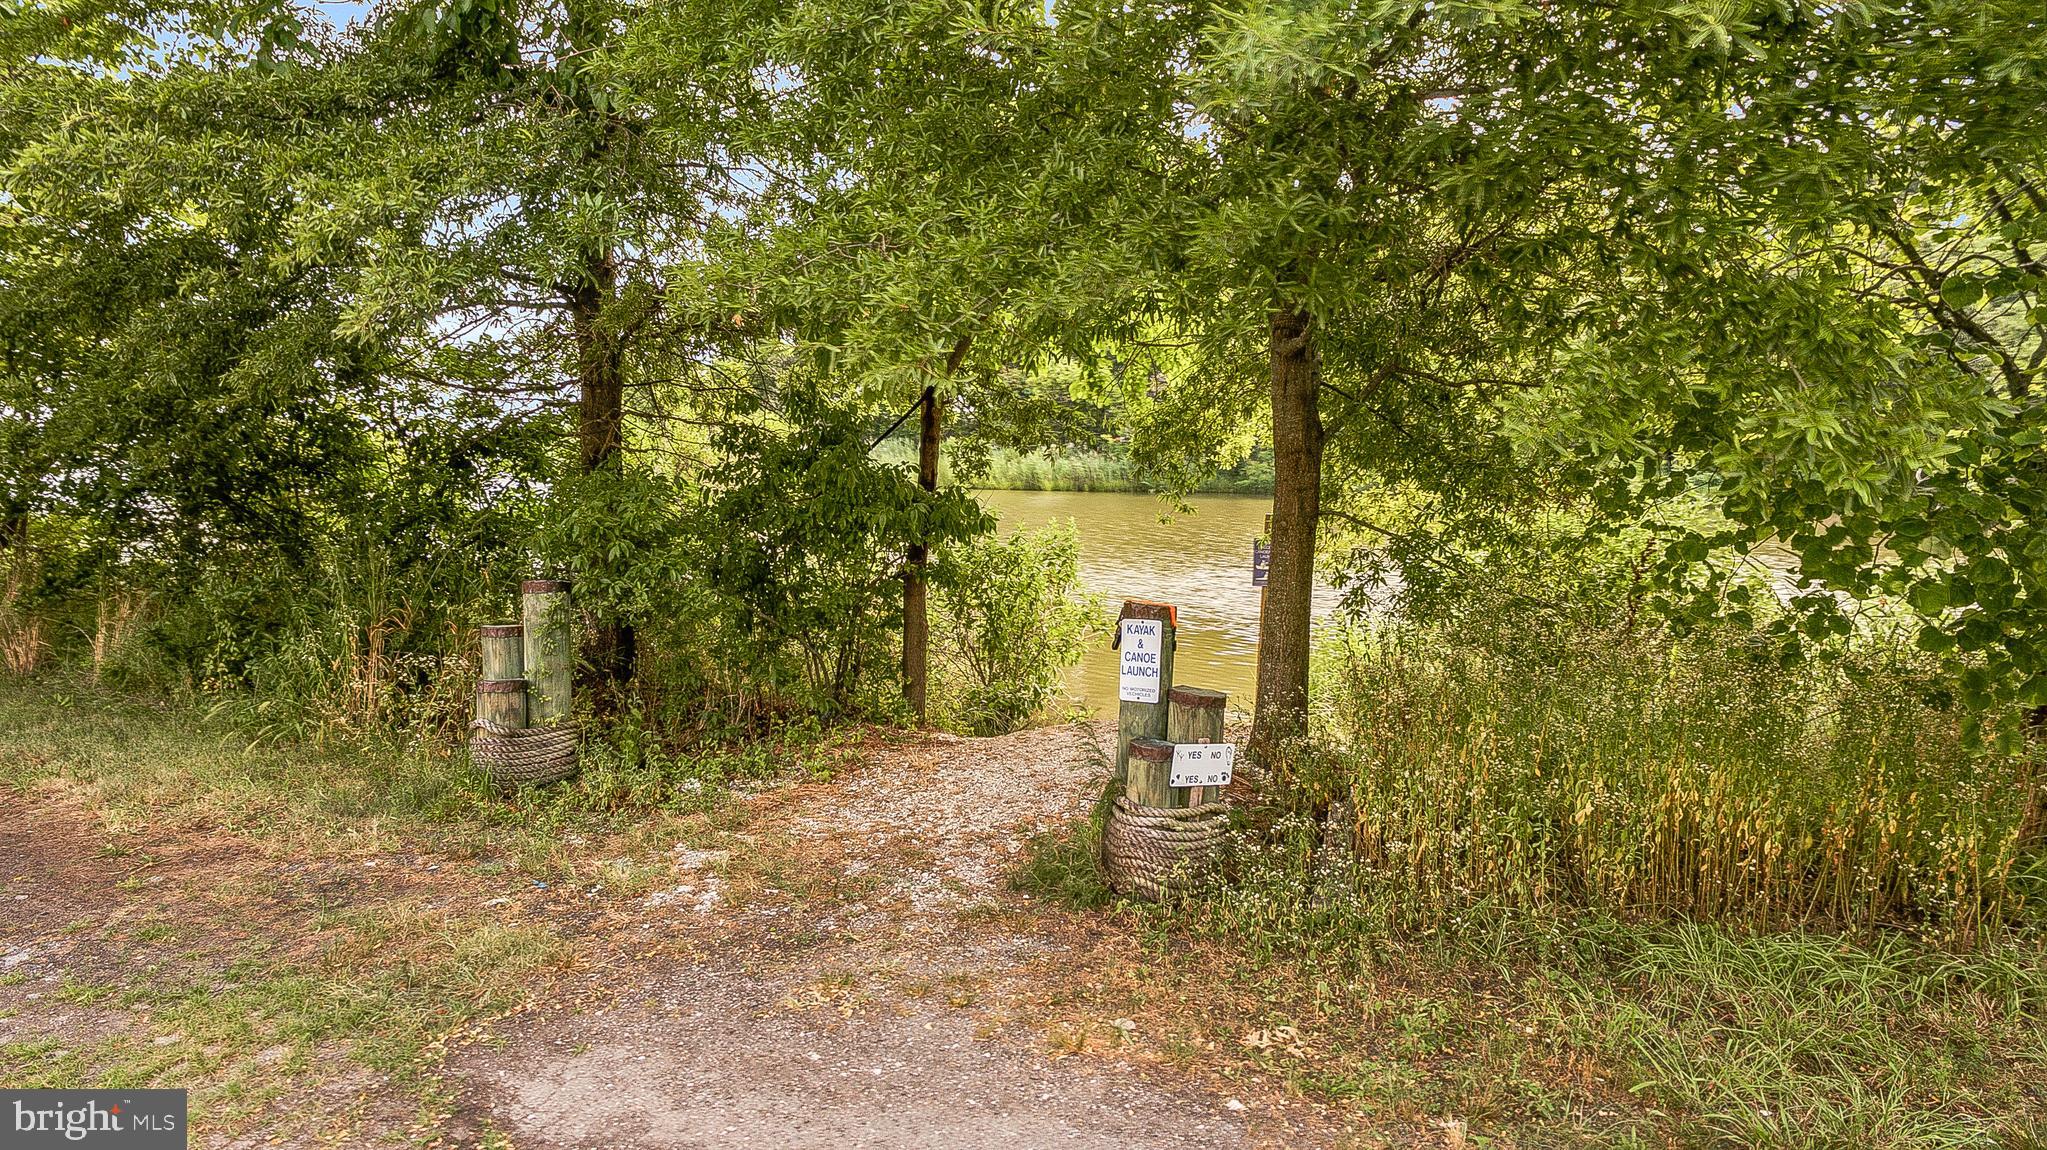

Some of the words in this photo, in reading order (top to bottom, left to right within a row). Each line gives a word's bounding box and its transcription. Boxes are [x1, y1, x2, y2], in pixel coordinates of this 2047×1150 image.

[1127, 624, 1155, 636] KAYAK
[1137, 638, 1144, 649] &
[1124, 651, 1156, 663] CANOE
[1121, 665, 1158, 678] LAUNCH
[1187, 751, 1202, 760] YES
[1210, 751, 1222, 760] NO
[1184, 774, 1199, 784] YES
[1207, 774, 1218, 783] NO
